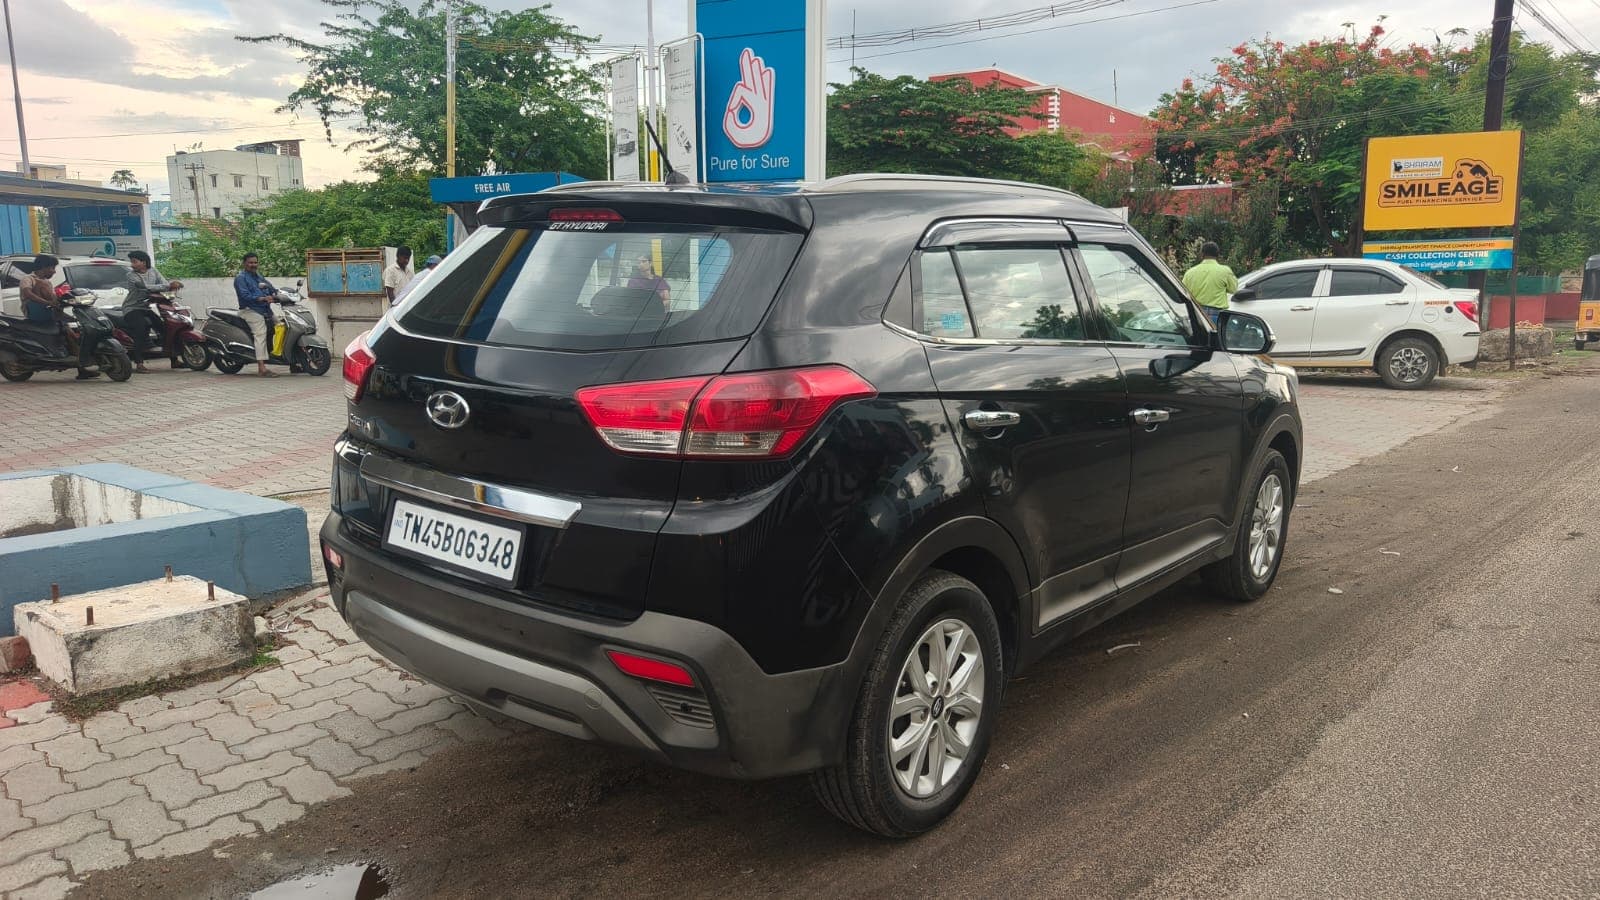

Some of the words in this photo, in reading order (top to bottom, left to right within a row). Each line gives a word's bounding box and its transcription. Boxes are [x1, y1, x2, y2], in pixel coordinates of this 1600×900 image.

[710, 156, 738, 170] Pure
[741, 154, 758, 169] for
[761, 154, 790, 168] Sure
[474, 183, 495, 193] FREE
[496, 182, 511, 192] AIR
[1383, 180, 1499, 199] SMILEAGE
[403, 512, 514, 569] TN45BQ6348
